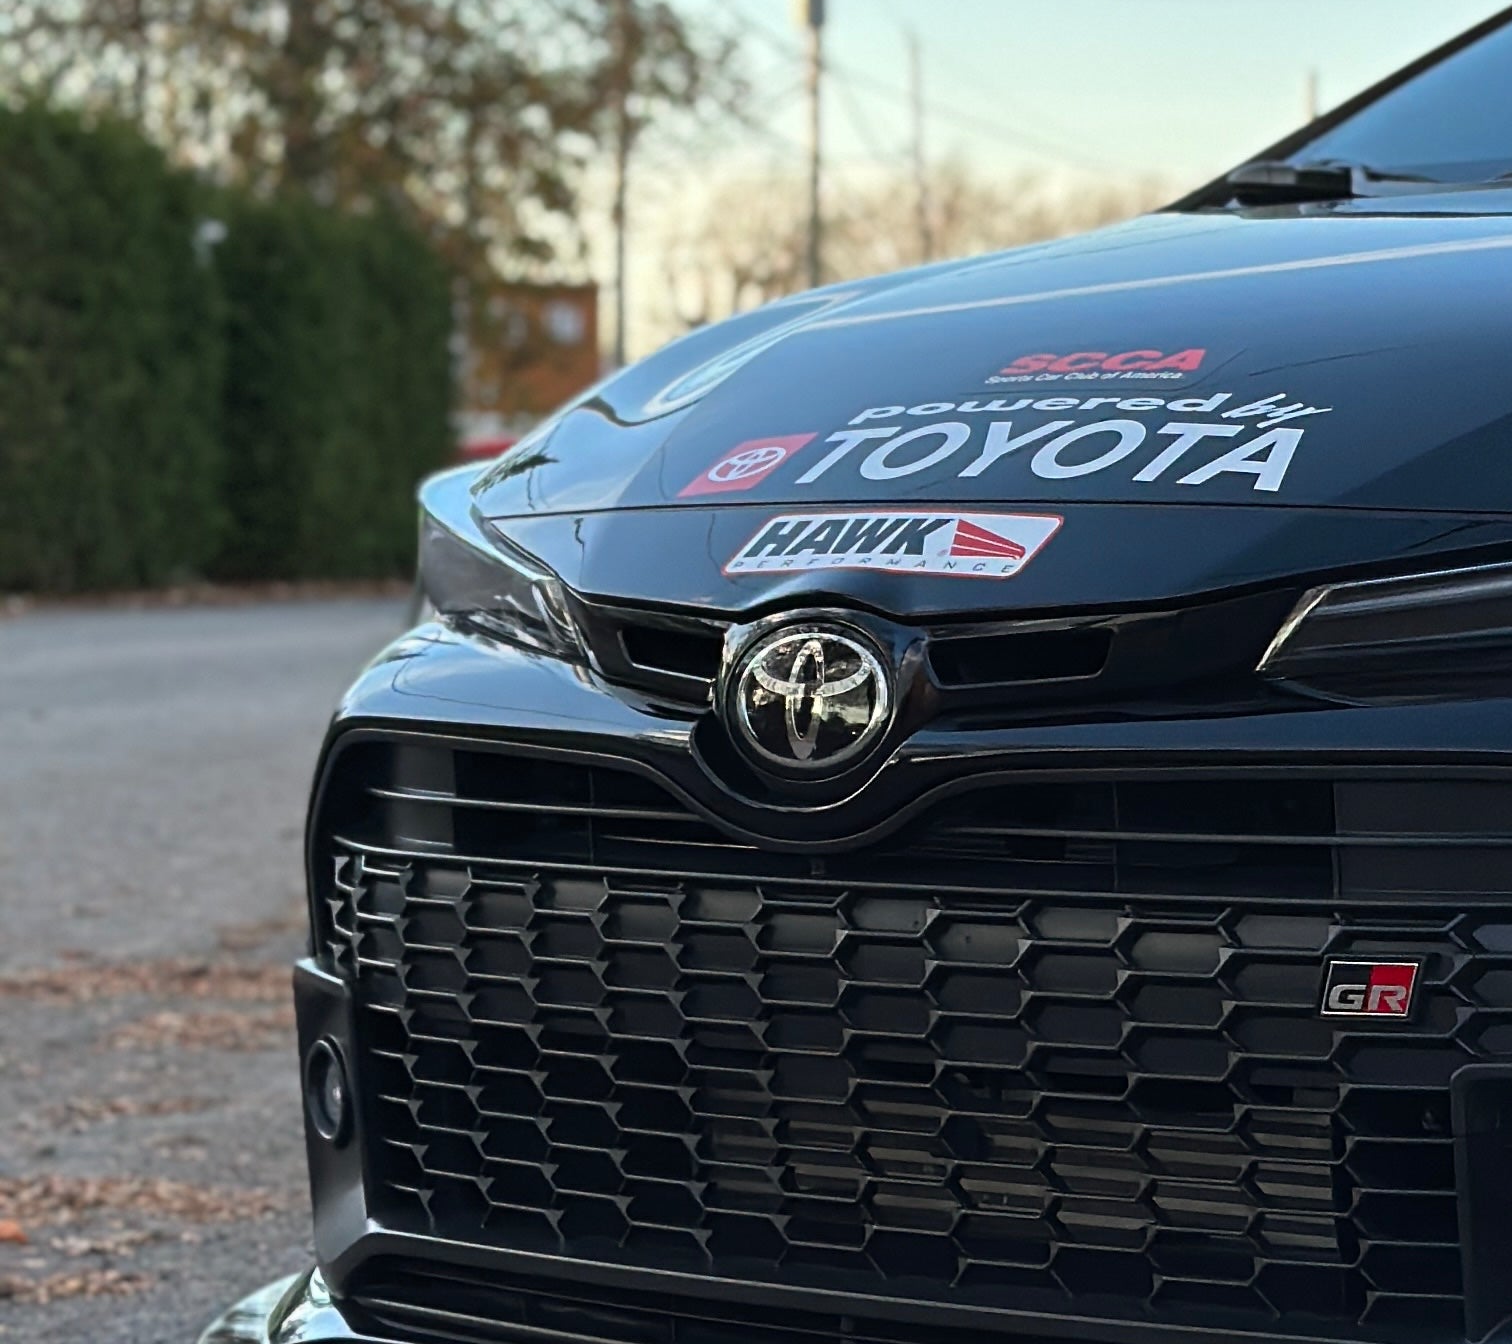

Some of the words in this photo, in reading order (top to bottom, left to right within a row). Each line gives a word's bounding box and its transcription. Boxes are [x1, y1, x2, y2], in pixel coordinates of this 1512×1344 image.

[1000, 348, 1207, 374] SCCA
[984, 374, 1034, 384] Sports
[1034, 373, 1064, 382] Car
[1063, 371, 1099, 381] Club
[1121, 370, 1184, 379] America
[847, 393, 1232, 425] powered
[1221, 393, 1334, 429] by
[795, 419, 1305, 492] TOYOTA
[743, 518, 956, 559] HAWK
[732, 557, 1017, 574] PERFORMANCE
[1328, 984, 1408, 1013] GR
